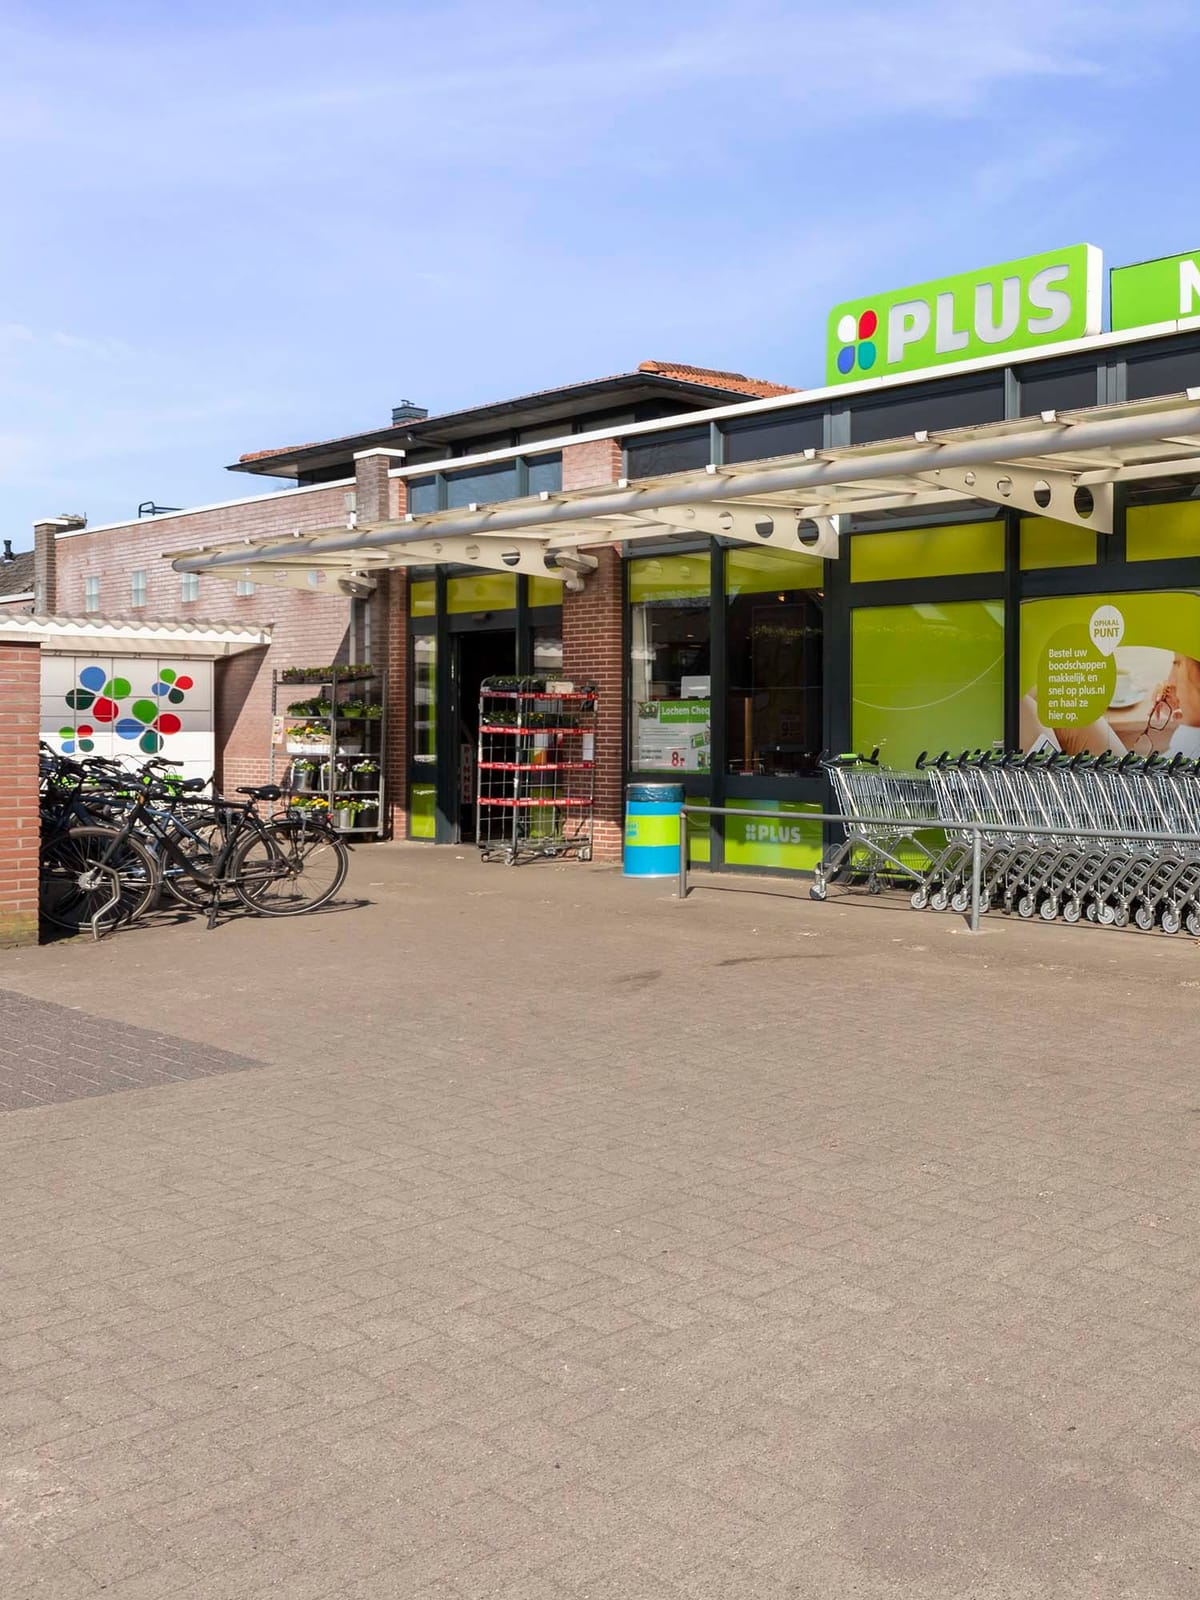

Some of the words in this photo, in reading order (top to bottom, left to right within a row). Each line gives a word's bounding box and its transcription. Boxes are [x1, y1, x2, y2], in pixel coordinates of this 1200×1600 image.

[887, 264, 1071, 363] PLUS
[1094, 619, 1120, 627] OPHAAL
[1094, 627, 1120, 638] PUNT
[1048, 648, 1072, 658] Bestel
[1074, 649, 1088, 657] uw
[1048, 660, 1107, 671] boodschappen
[1048, 672, 1086, 684] makkelijk
[1087, 674, 1098, 682] en
[1048, 686, 1065, 695] snel
[1066, 687, 1077, 697] op
[1079, 685, 1106, 697] plus.nl
[1048, 699, 1059, 707] en
[1060, 697, 1077, 707] haal
[1079, 699, 1089, 707] ze
[662, 705, 690, 715] Lochem
[1048, 709, 1064, 720] hier
[1065, 711, 1078, 721] op.
[758, 825, 801, 844] PLUS
